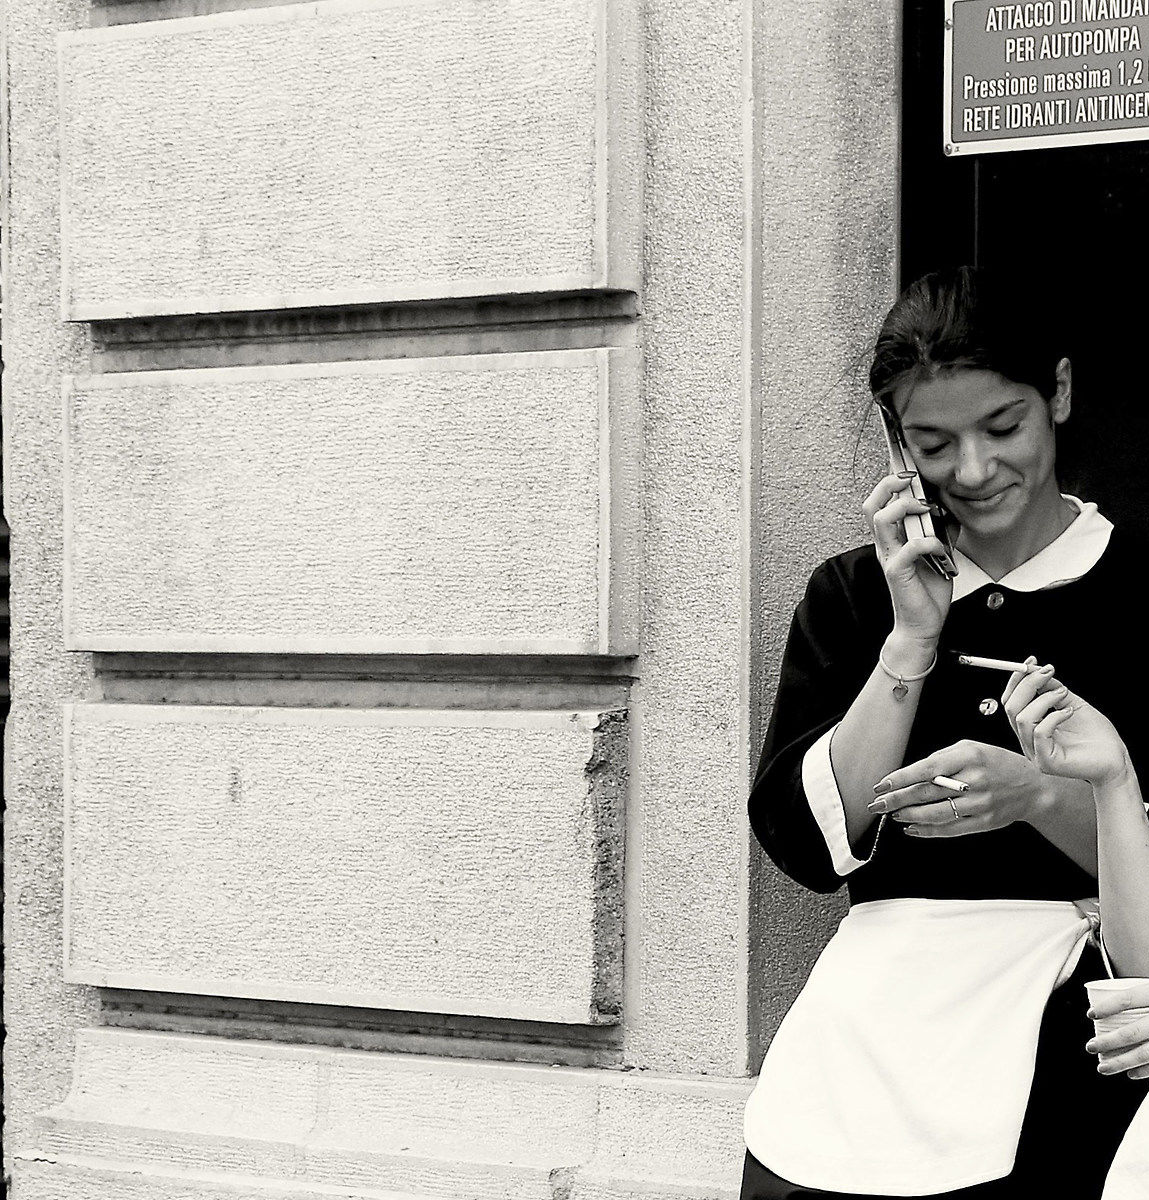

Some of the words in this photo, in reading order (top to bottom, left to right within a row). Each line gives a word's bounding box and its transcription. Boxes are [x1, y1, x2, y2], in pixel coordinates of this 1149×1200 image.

[985, 0, 1054, 33] ATTACCO
[1060, 0, 1077, 25] DI
[1005, 36, 1035, 63] PER
[1039, 25, 1141, 60] AUTOPOMPA
[963, 73, 1037, 100] Pressione
[1043, 63, 1111, 93] massima
[1117, 58, 1144, 88] 1,2
[963, 106, 1001, 133] RETE
[1005, 99, 1070, 130] IDRANTI
